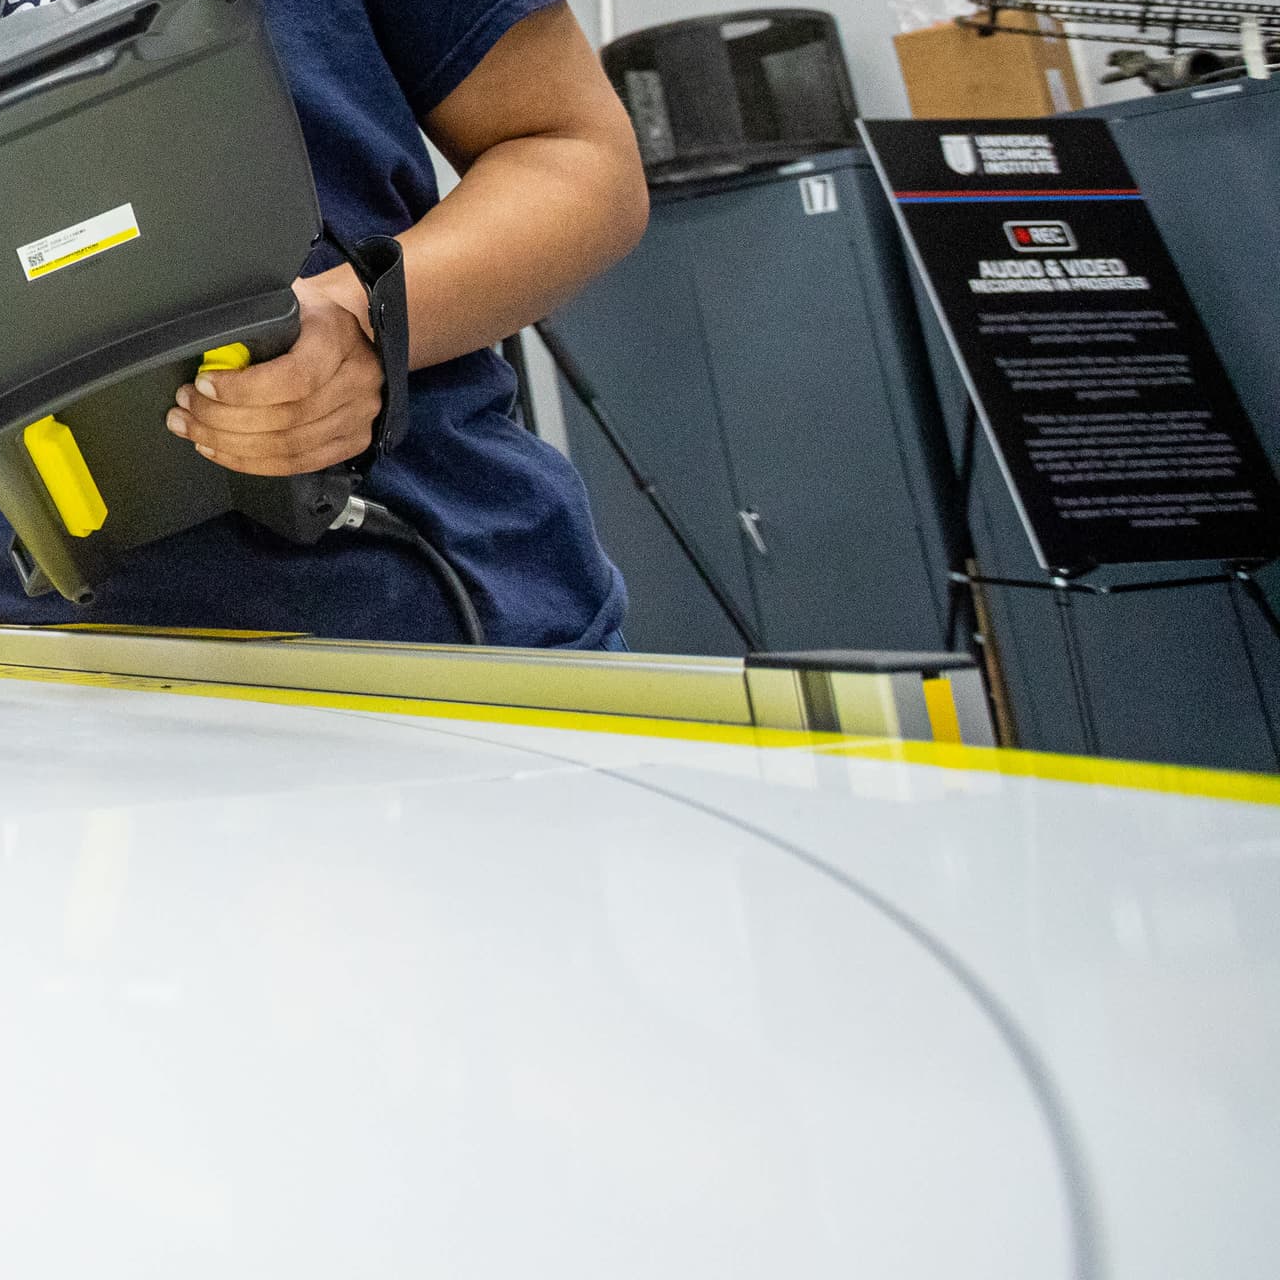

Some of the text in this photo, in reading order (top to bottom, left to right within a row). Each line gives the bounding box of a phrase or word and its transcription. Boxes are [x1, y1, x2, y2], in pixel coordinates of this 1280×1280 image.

[975, 134, 1053, 148] UNIVERSAL
[978, 147, 1057, 161] TECHNICAL
[983, 160, 1060, 174] INSTITUTE
[1028, 227, 1068, 245] REC
[978, 258, 1128, 278] AUDIO & VIDEO
[968, 275, 1151, 293] RECORDING IN PROGRESS
